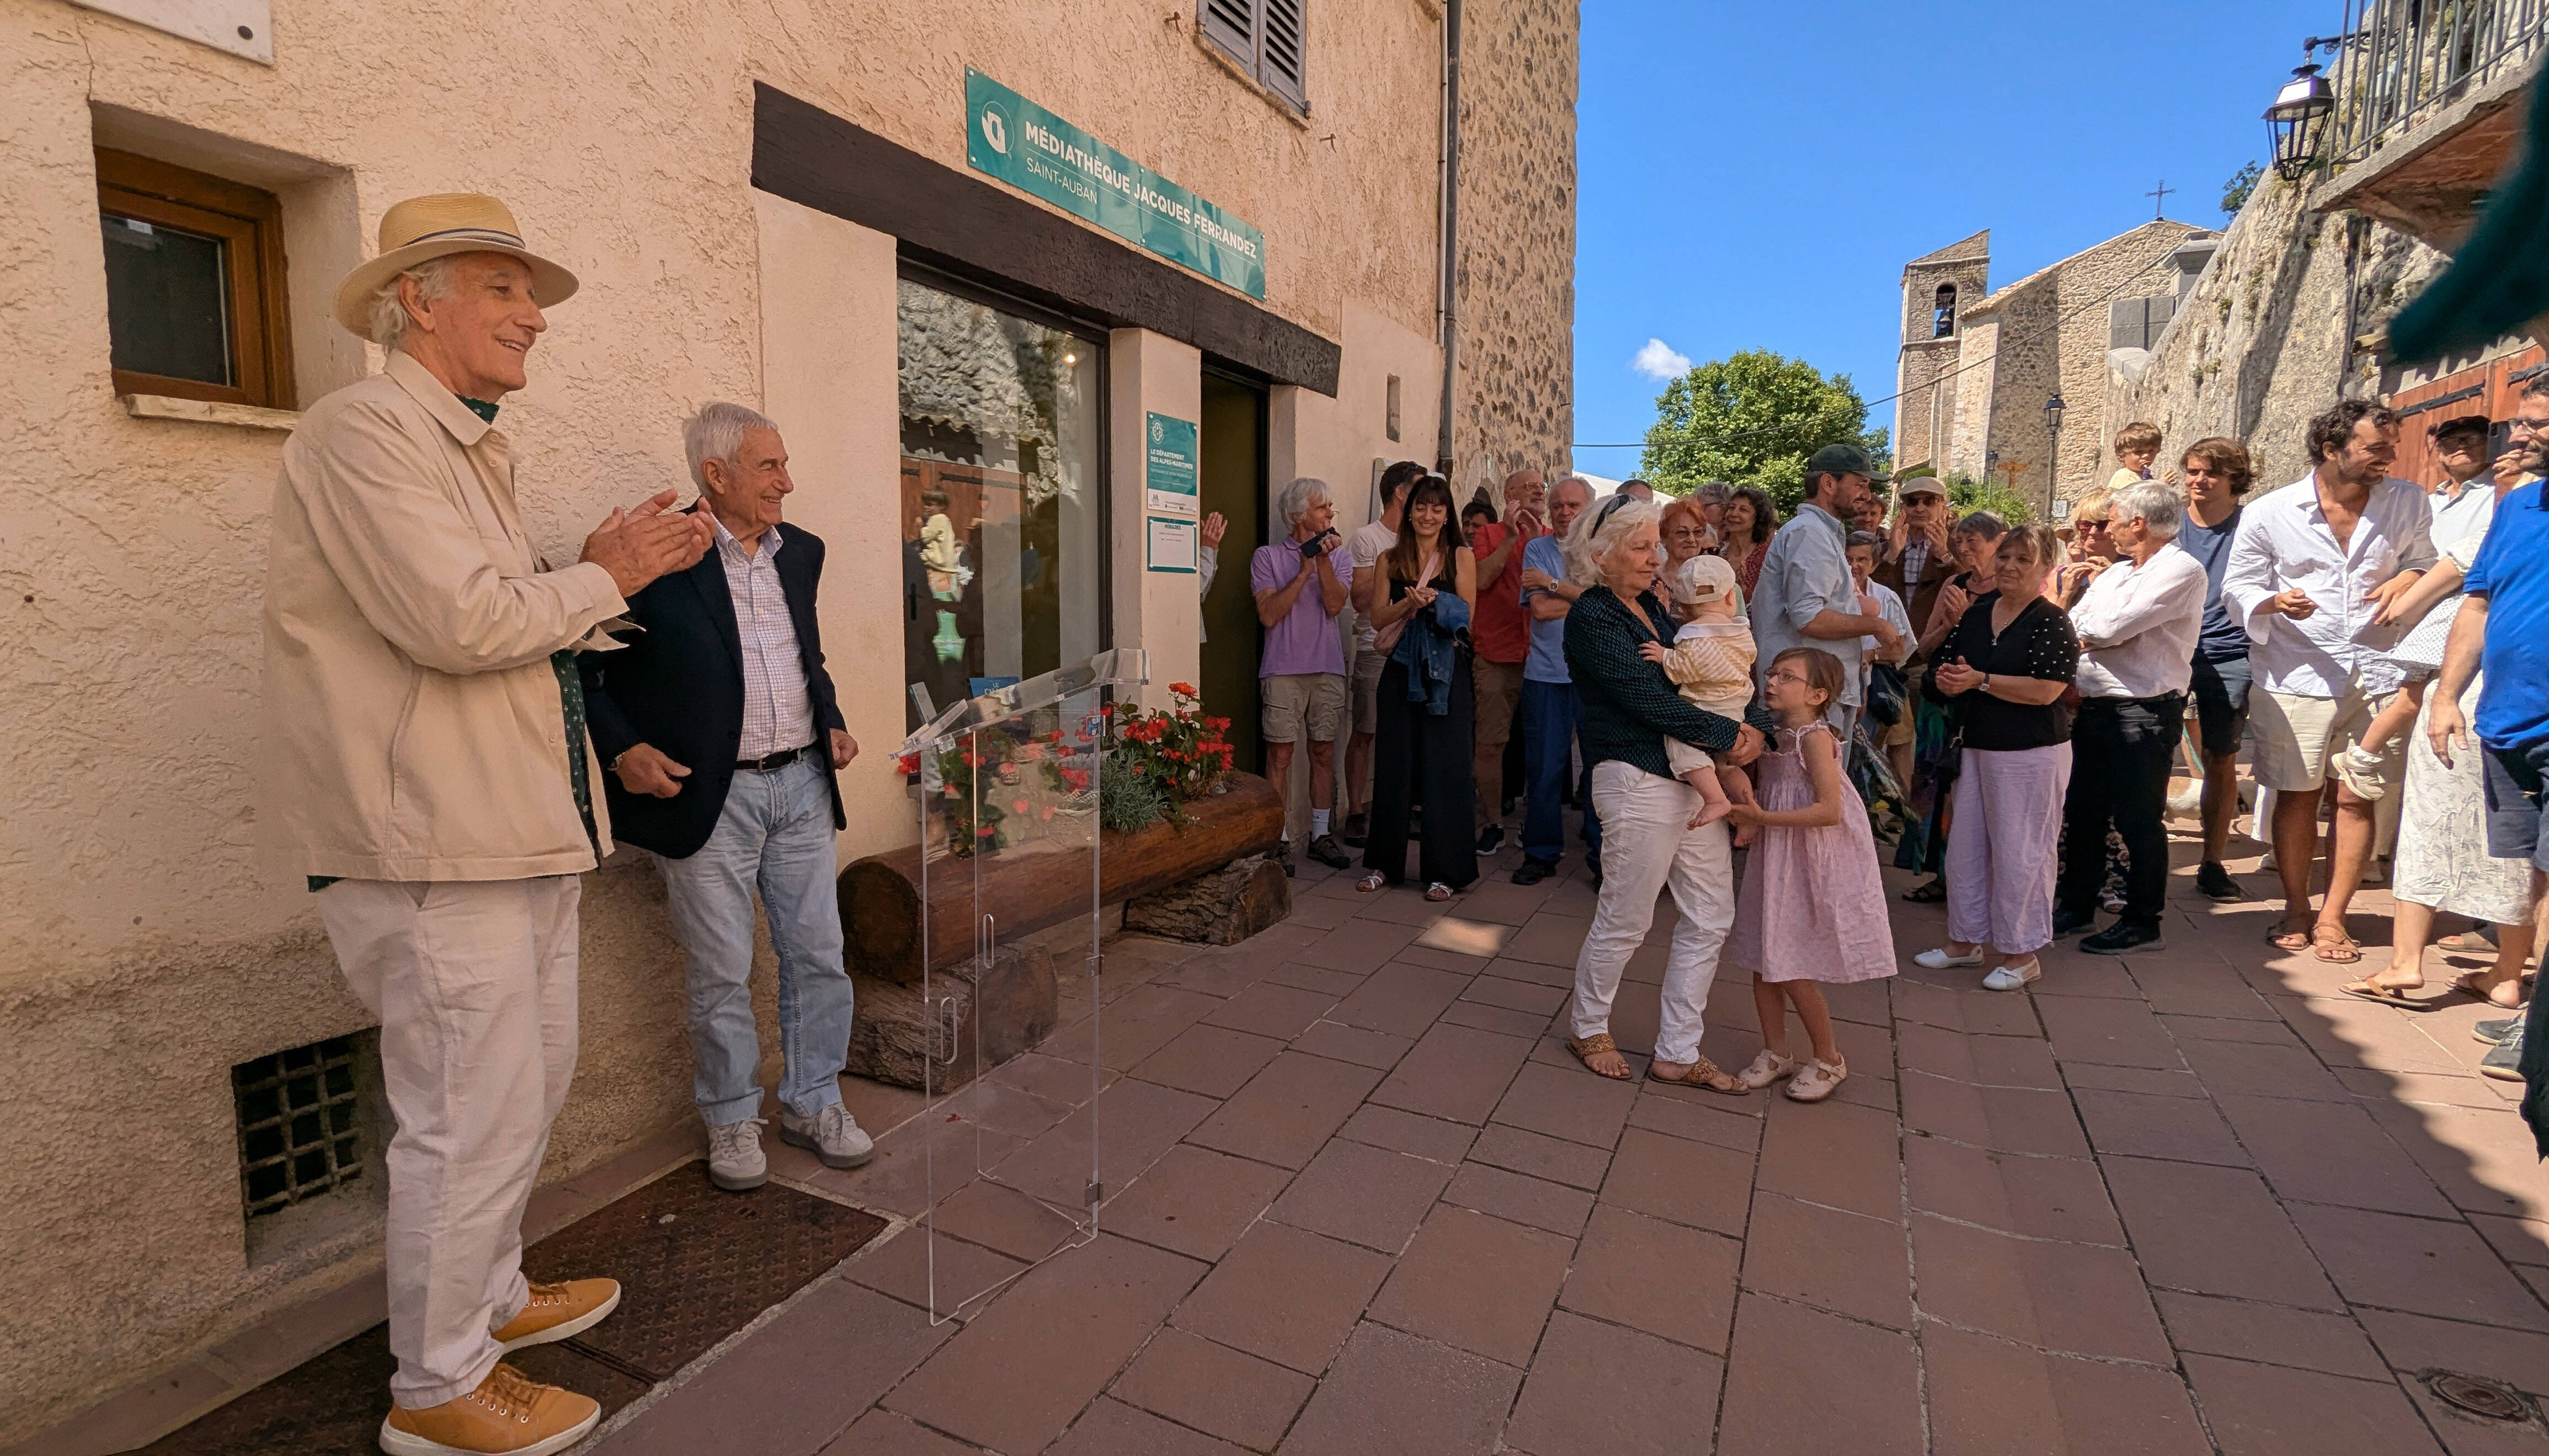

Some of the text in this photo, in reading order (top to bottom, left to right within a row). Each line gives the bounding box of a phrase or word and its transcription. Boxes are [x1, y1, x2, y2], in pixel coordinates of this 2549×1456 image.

[1026, 120, 1256, 259] MÉDIATHÈQUE JACQUES FERRANDEZ
[1027, 157, 1097, 205] SAINT-AUBAN
[1156, 449, 1185, 460] DÉPARTEMENT
[1159, 458, 1193, 470] ALPES-MARITIMES
